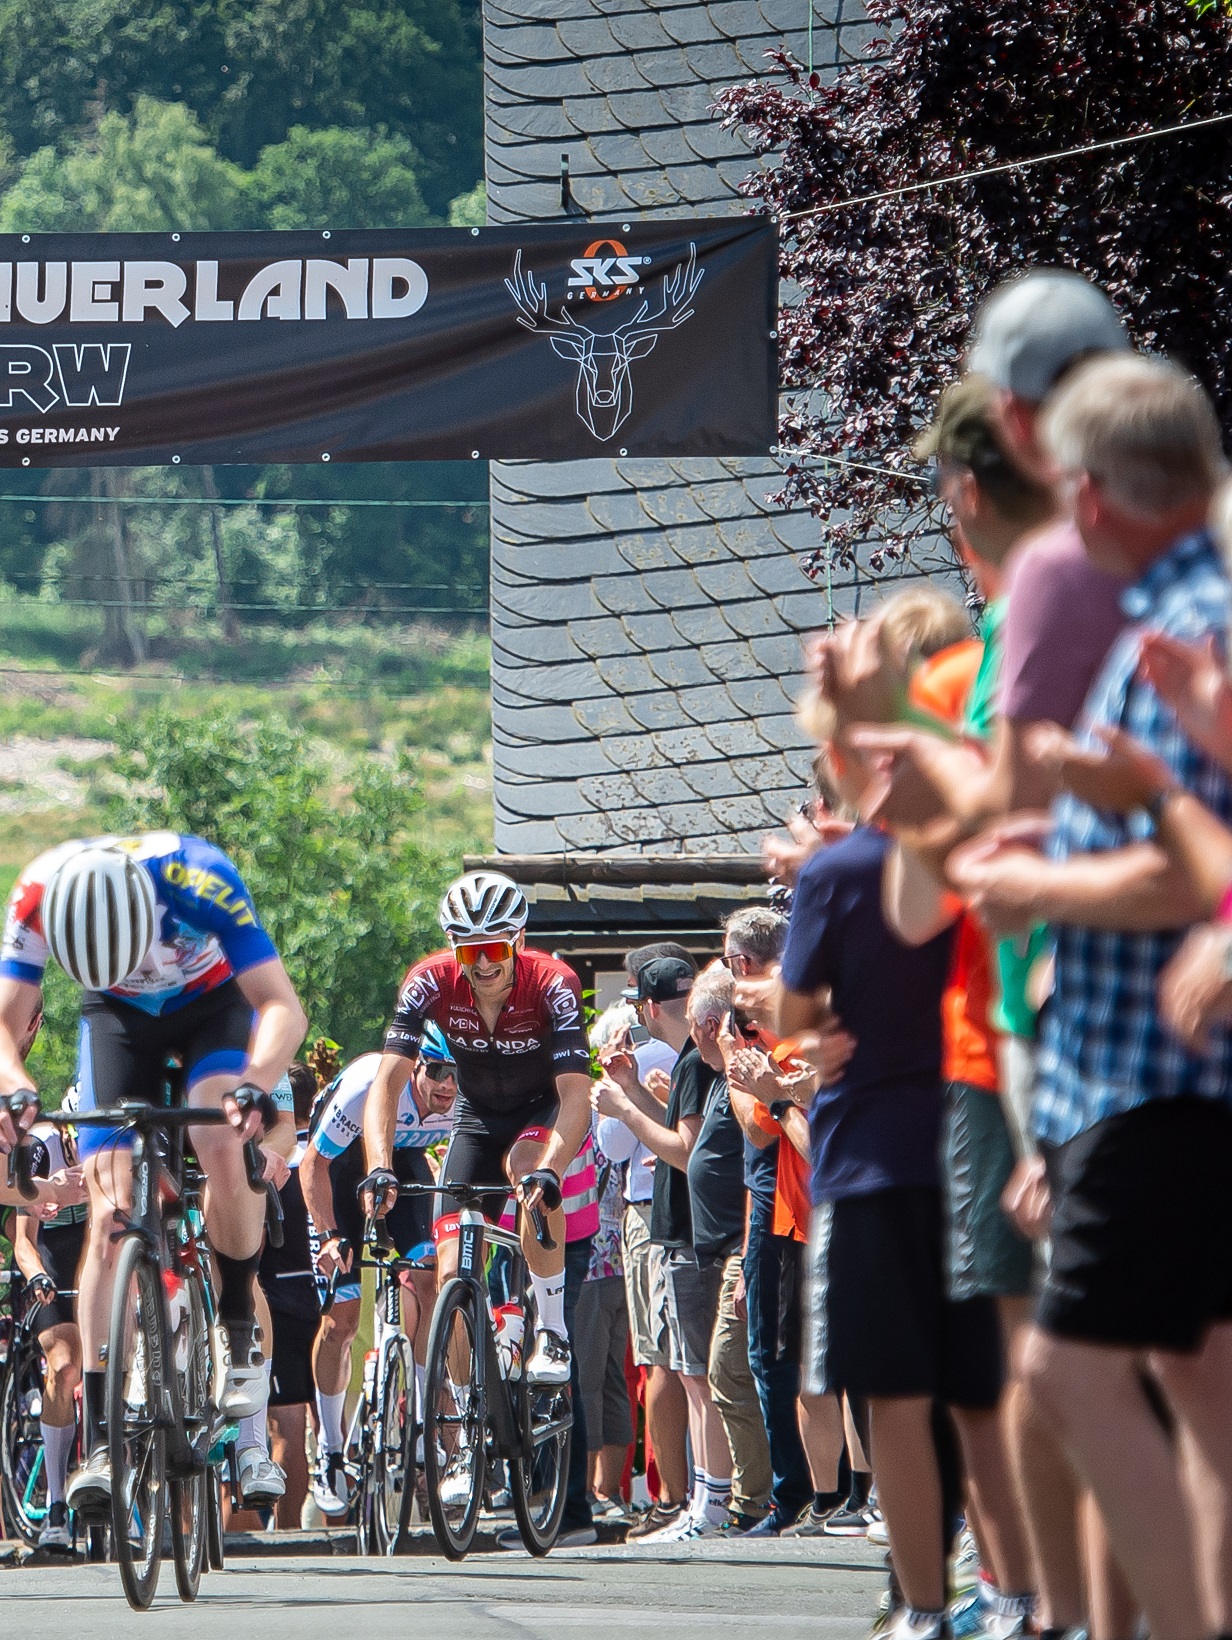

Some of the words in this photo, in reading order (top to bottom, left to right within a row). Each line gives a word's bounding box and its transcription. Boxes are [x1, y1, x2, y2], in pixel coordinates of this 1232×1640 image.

[568, 256, 643, 287] SKS
[567, 286, 645, 300] GERMANY
[15, 426, 121, 444] GERMANY
[460, 1231, 474, 1272] BMC
